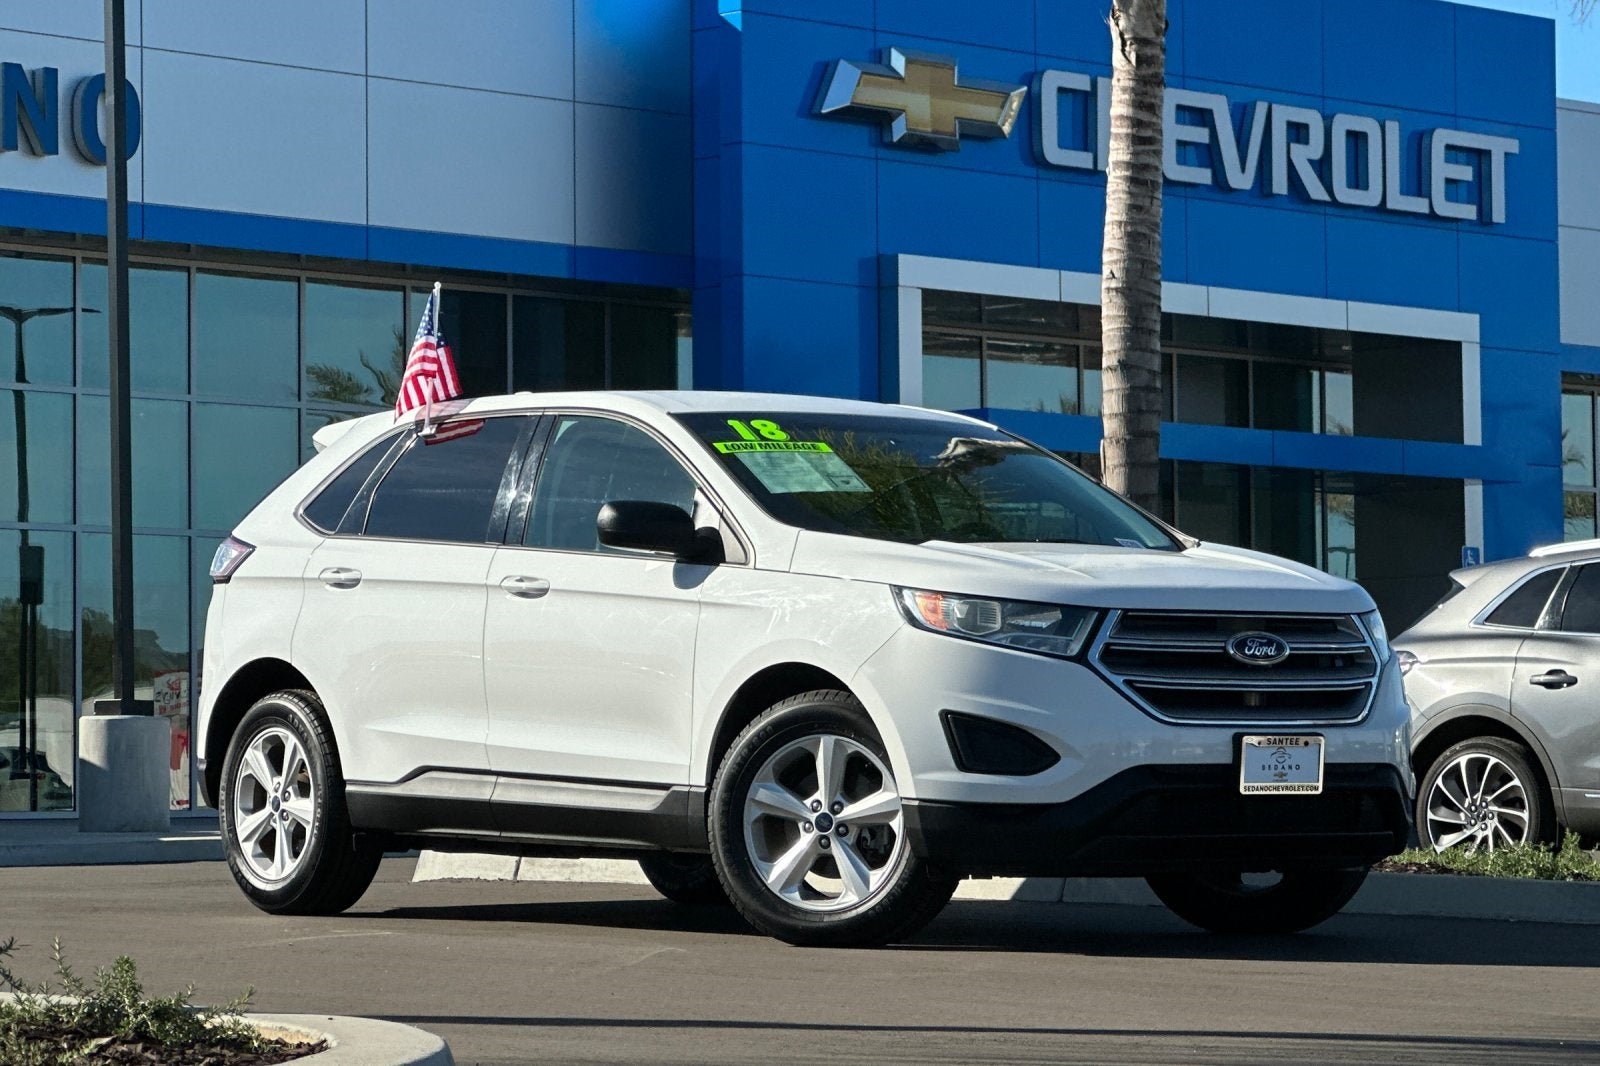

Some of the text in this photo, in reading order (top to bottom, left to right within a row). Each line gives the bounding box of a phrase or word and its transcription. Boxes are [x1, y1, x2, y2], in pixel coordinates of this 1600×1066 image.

[1038, 69, 1520, 224] CEVROLET
[726, 419, 790, 442] 18
[725, 442, 819, 451] LOW MILEAGE
[1244, 637, 1277, 656] Ford
[1266, 737, 1300, 746] SANTEE
